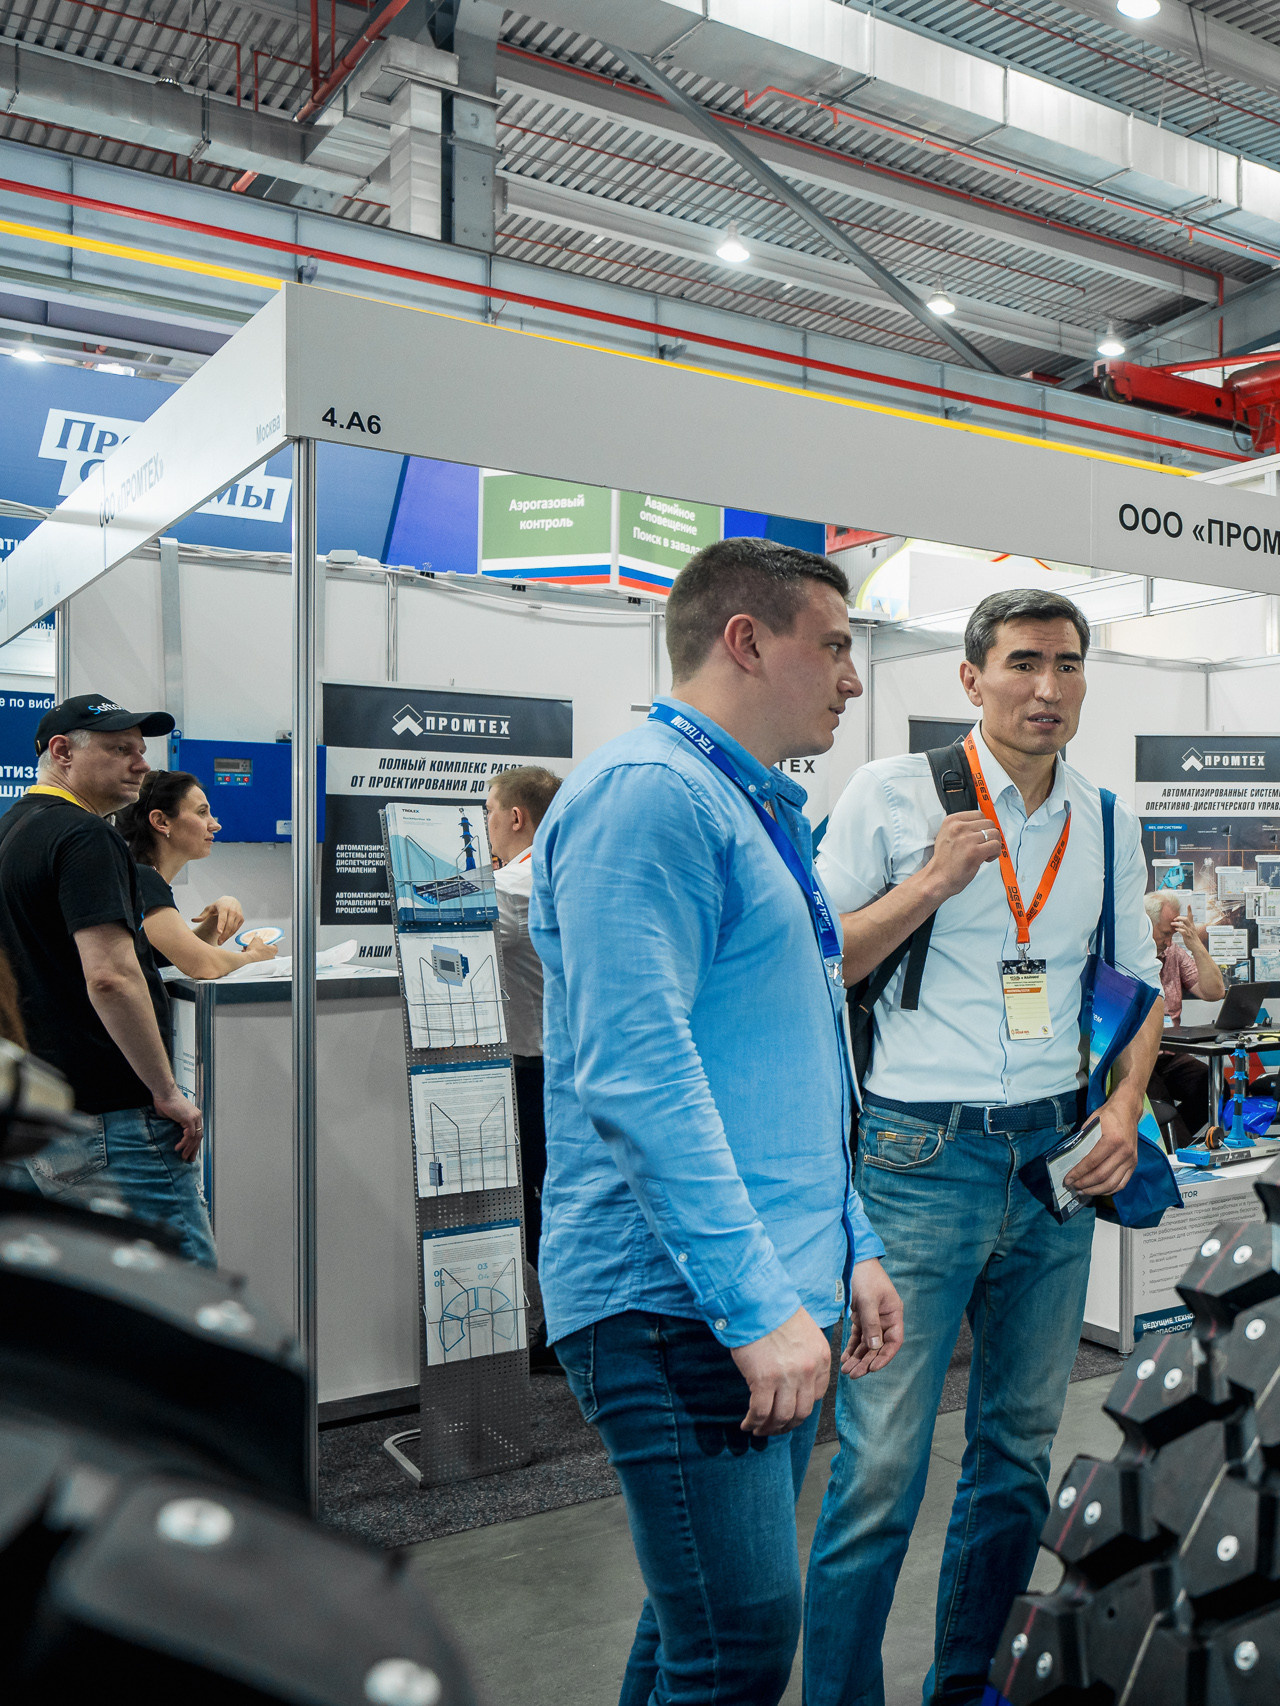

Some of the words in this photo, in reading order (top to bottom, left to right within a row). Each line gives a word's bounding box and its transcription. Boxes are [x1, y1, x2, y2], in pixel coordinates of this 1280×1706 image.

[321, 406, 382, 435] 4.А6
[255, 414, 281, 446] Москва
[508, 494, 585, 513] Аэрогазовый
[644, 495, 696, 522] Аварийное
[519, 518, 574, 532] контроль
[639, 509, 698, 536] оповещение
[1118, 503, 1183, 539] ООО
[632, 526, 662, 548] Поиск
[663, 538, 669, 548] в
[9, 698, 25, 709] по
[425, 716, 511, 735] ПРОМТЕХ
[378, 757, 427, 771] ПОЛНЫЙ
[429, 760, 488, 774] КОМПЛЕКС
[1204, 755, 1265, 767] ПРОМТЕХ
[350, 775, 366, 788] ОТ
[368, 775, 468, 792] ПРОЕКТИРОВАНИЯ
[470, 780, 485, 793] ДО
[1161, 788, 1248, 798] АВТОМАТИЗИРОВАННЫЕ
[1145, 801, 1255, 812] ОПЕРАТИВНО-ДИСПЕТЧЕРСКОГО
[336, 906, 378, 914] ПРОЦЕССАМИ
[359, 945, 393, 958] НАШИ
[477, 1263, 488, 1271] 03
[1142, 1317, 1173, 1330] ВЕДУЩИЕ
